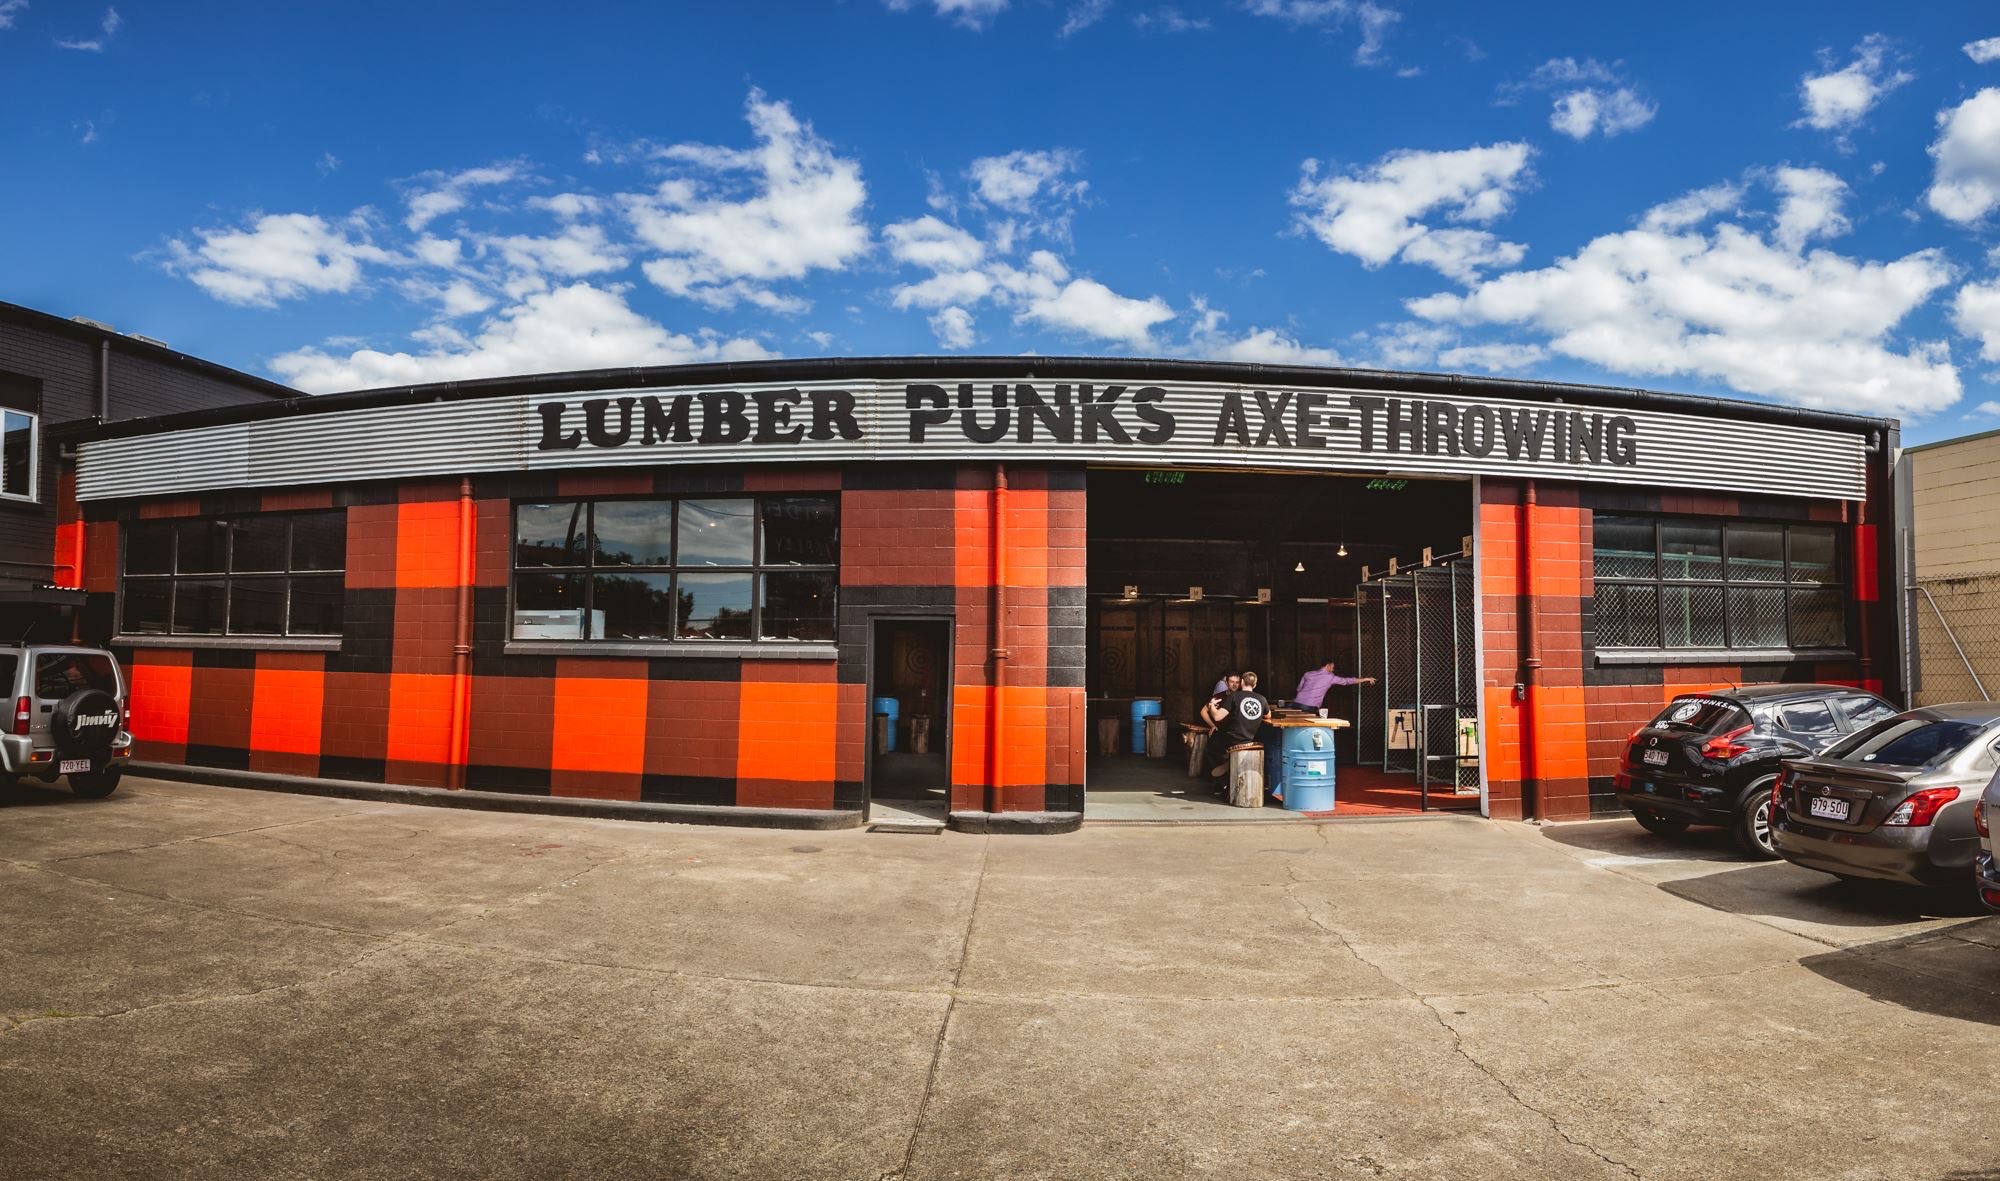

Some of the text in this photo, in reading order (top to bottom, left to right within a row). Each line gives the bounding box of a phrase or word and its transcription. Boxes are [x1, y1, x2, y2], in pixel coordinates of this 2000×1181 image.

[537, 384, 1637, 467] LUMBER PUNKS AXE-THROWING
[74, 714, 118, 731] Jimny
